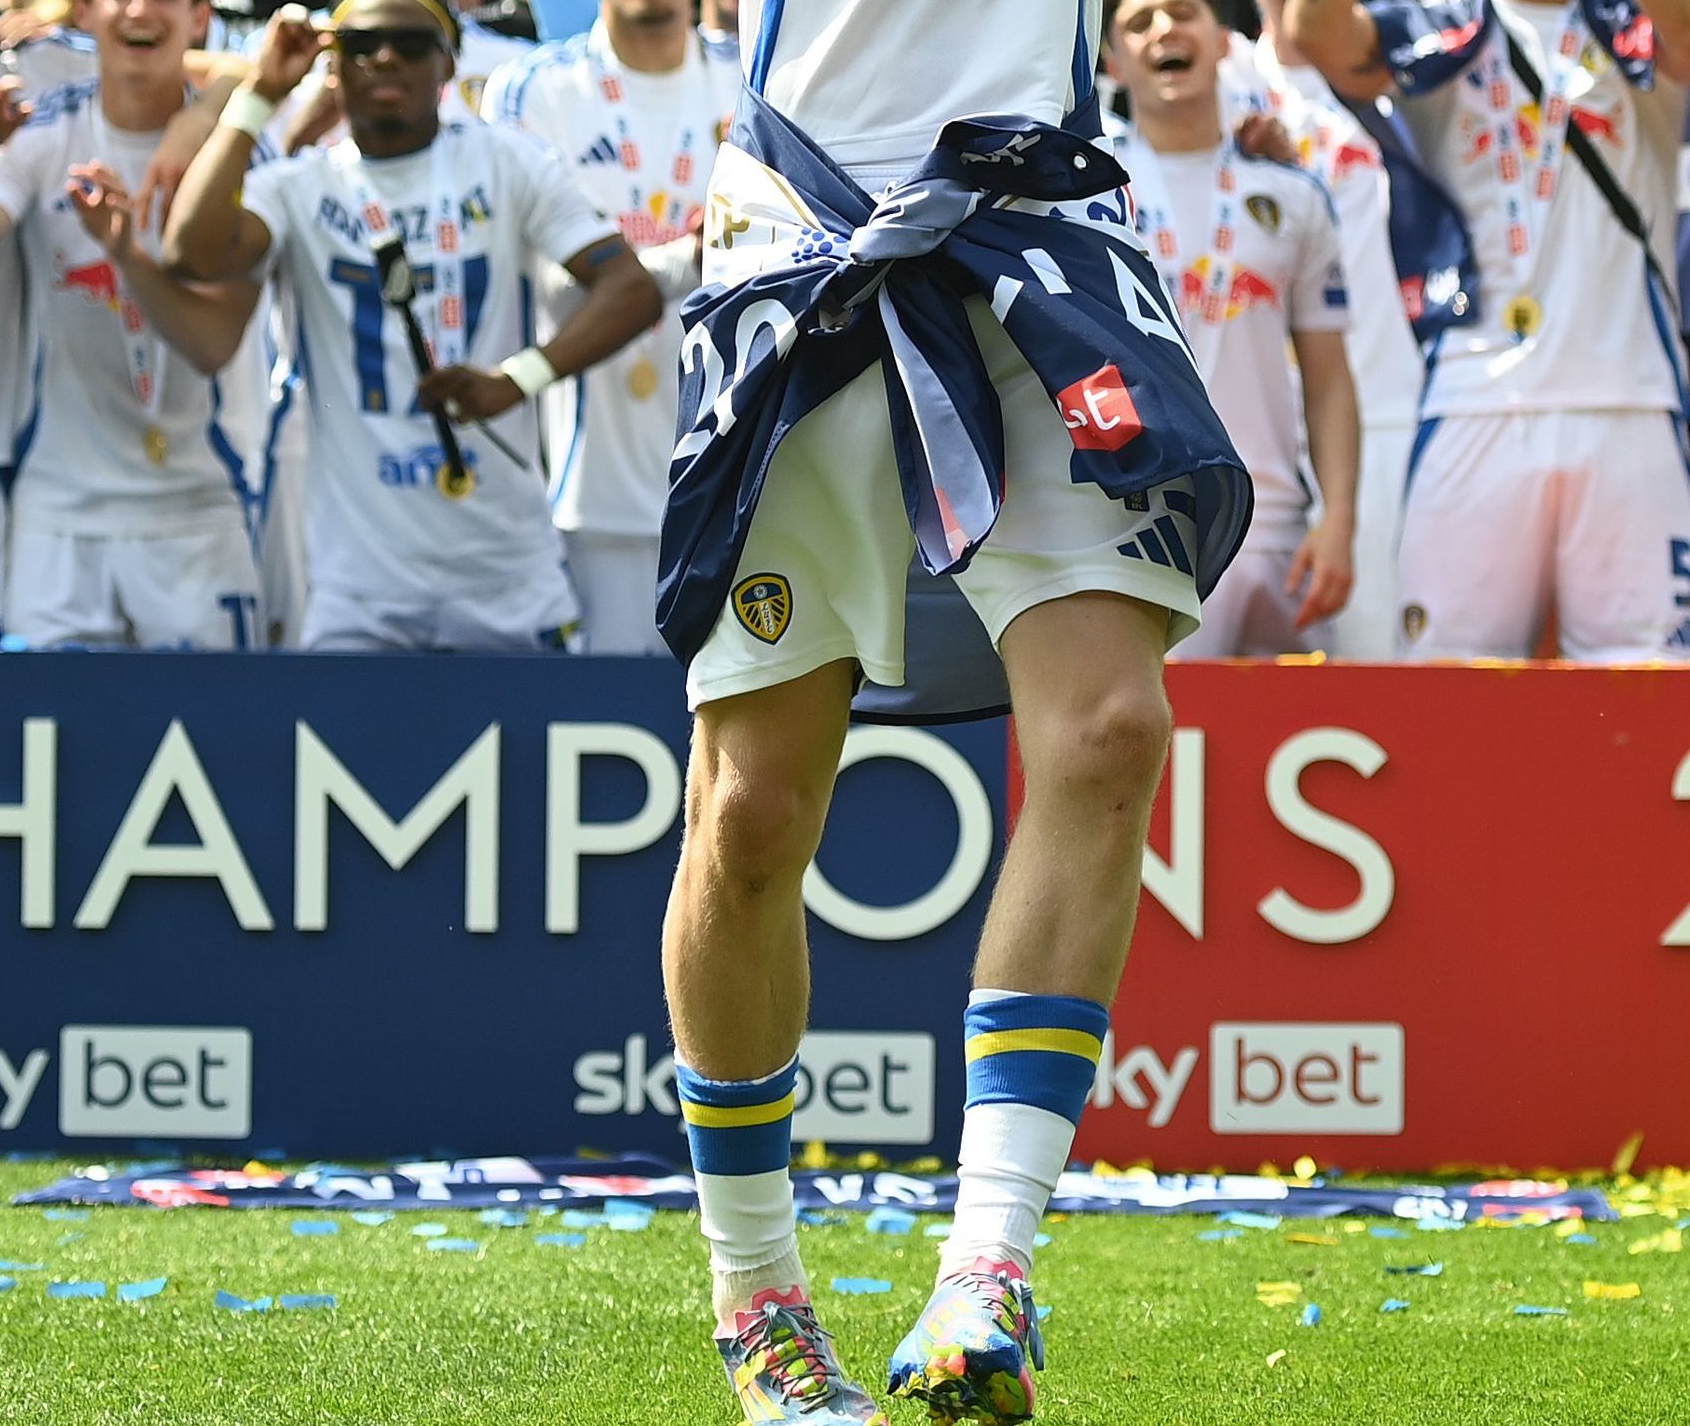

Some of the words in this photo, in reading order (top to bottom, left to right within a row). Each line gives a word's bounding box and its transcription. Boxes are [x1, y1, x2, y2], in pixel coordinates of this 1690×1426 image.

[82, 1038, 231, 1110] bet
[573, 1033, 684, 1132] sk
[1087, 1029, 1199, 1128] ky
[1234, 1038, 1381, 1106] bet
